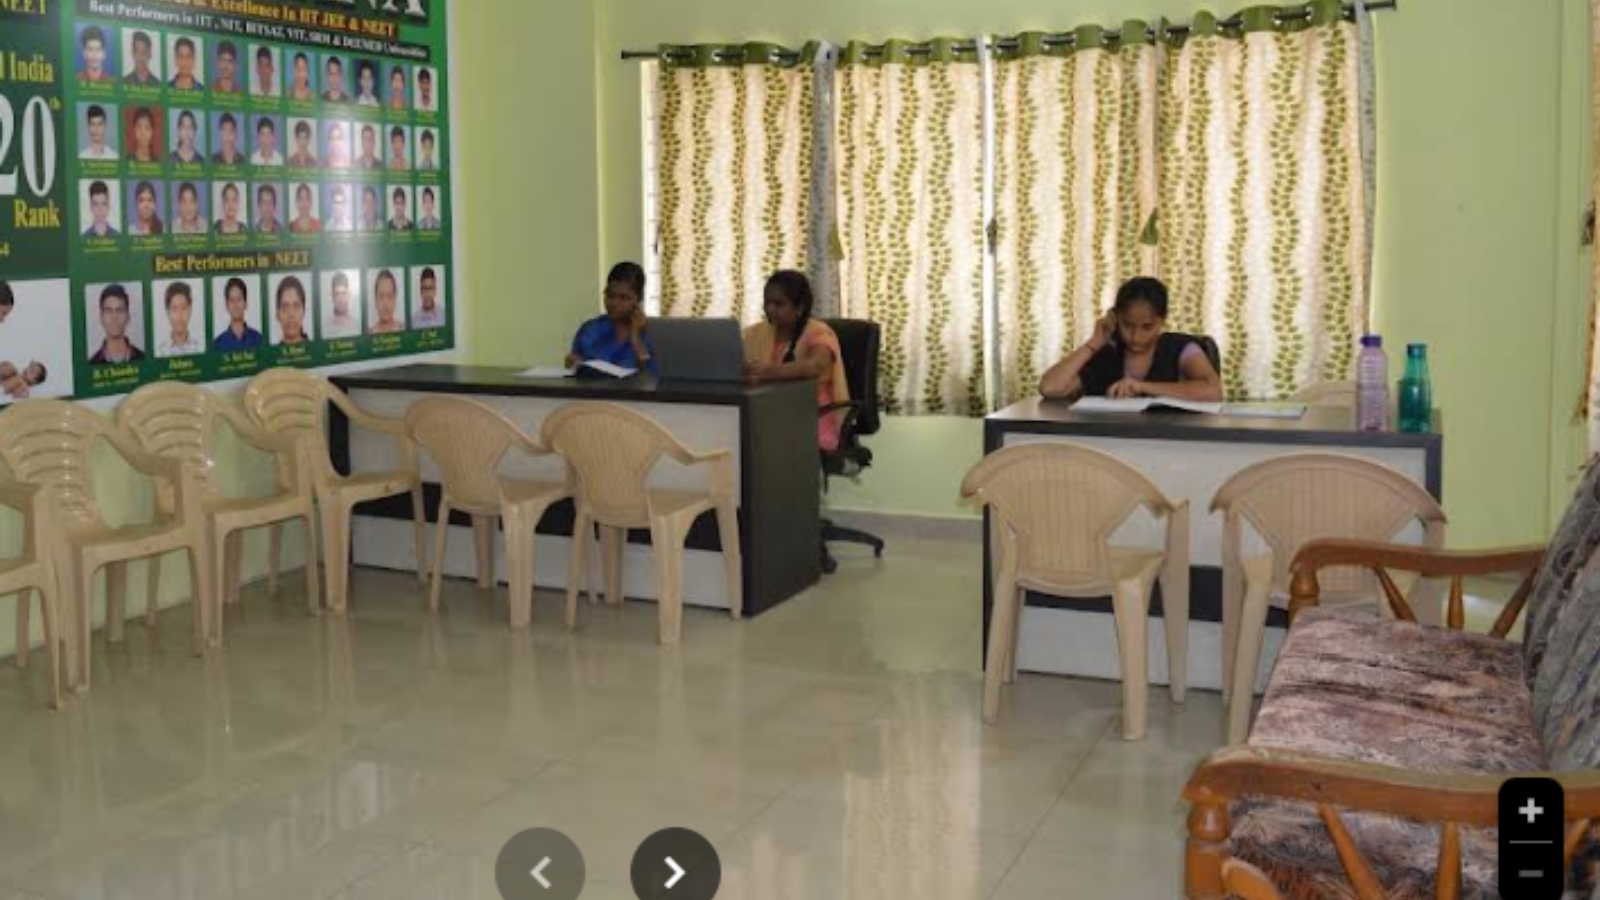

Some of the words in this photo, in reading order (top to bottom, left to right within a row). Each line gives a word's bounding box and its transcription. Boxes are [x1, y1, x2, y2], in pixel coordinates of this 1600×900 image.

[89, 1, 113, 16] Best
[117, 4, 180, 24] Performers
[361, 19, 395, 37] NEET
[11, 51, 54, 83] India
[14, 198, 61, 228] Rank
[155, 255, 184, 273] Best
[187, 253, 256, 271] Performers
[257, 252, 272, 267] in
[275, 250, 309, 267] NEET
